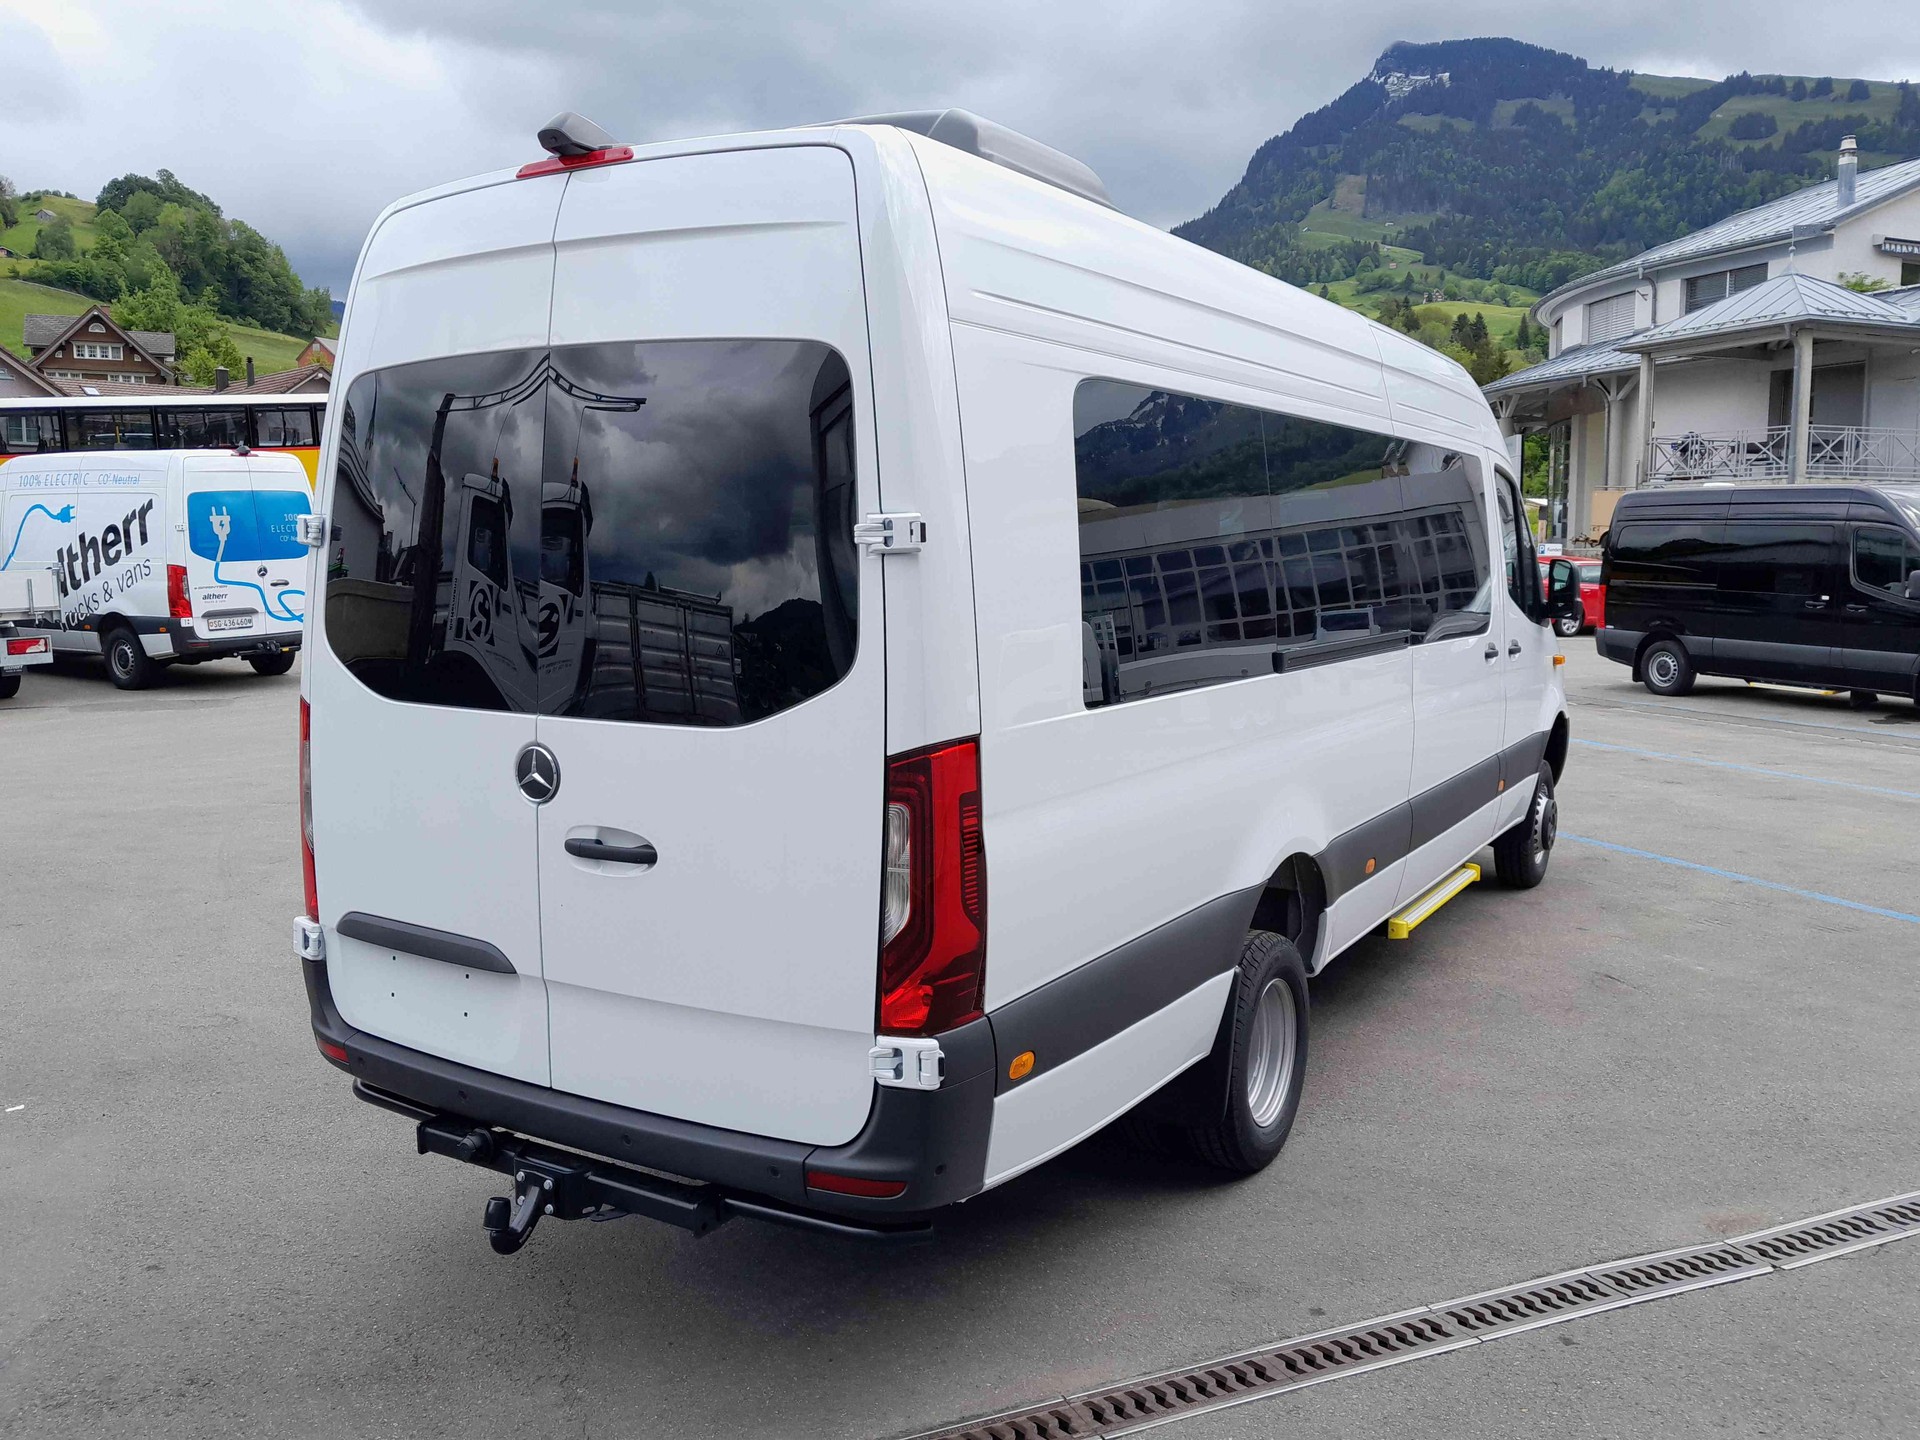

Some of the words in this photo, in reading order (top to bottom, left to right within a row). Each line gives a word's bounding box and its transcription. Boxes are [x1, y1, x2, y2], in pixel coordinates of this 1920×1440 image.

[19, 474, 41, 487] 100%
[44, 473, 90, 486] ELECTRIC
[57, 498, 153, 598] ltherr
[271, 524, 297, 533] ELECT
[60, 593, 100, 632] rucks
[116, 559, 151, 593] vans
